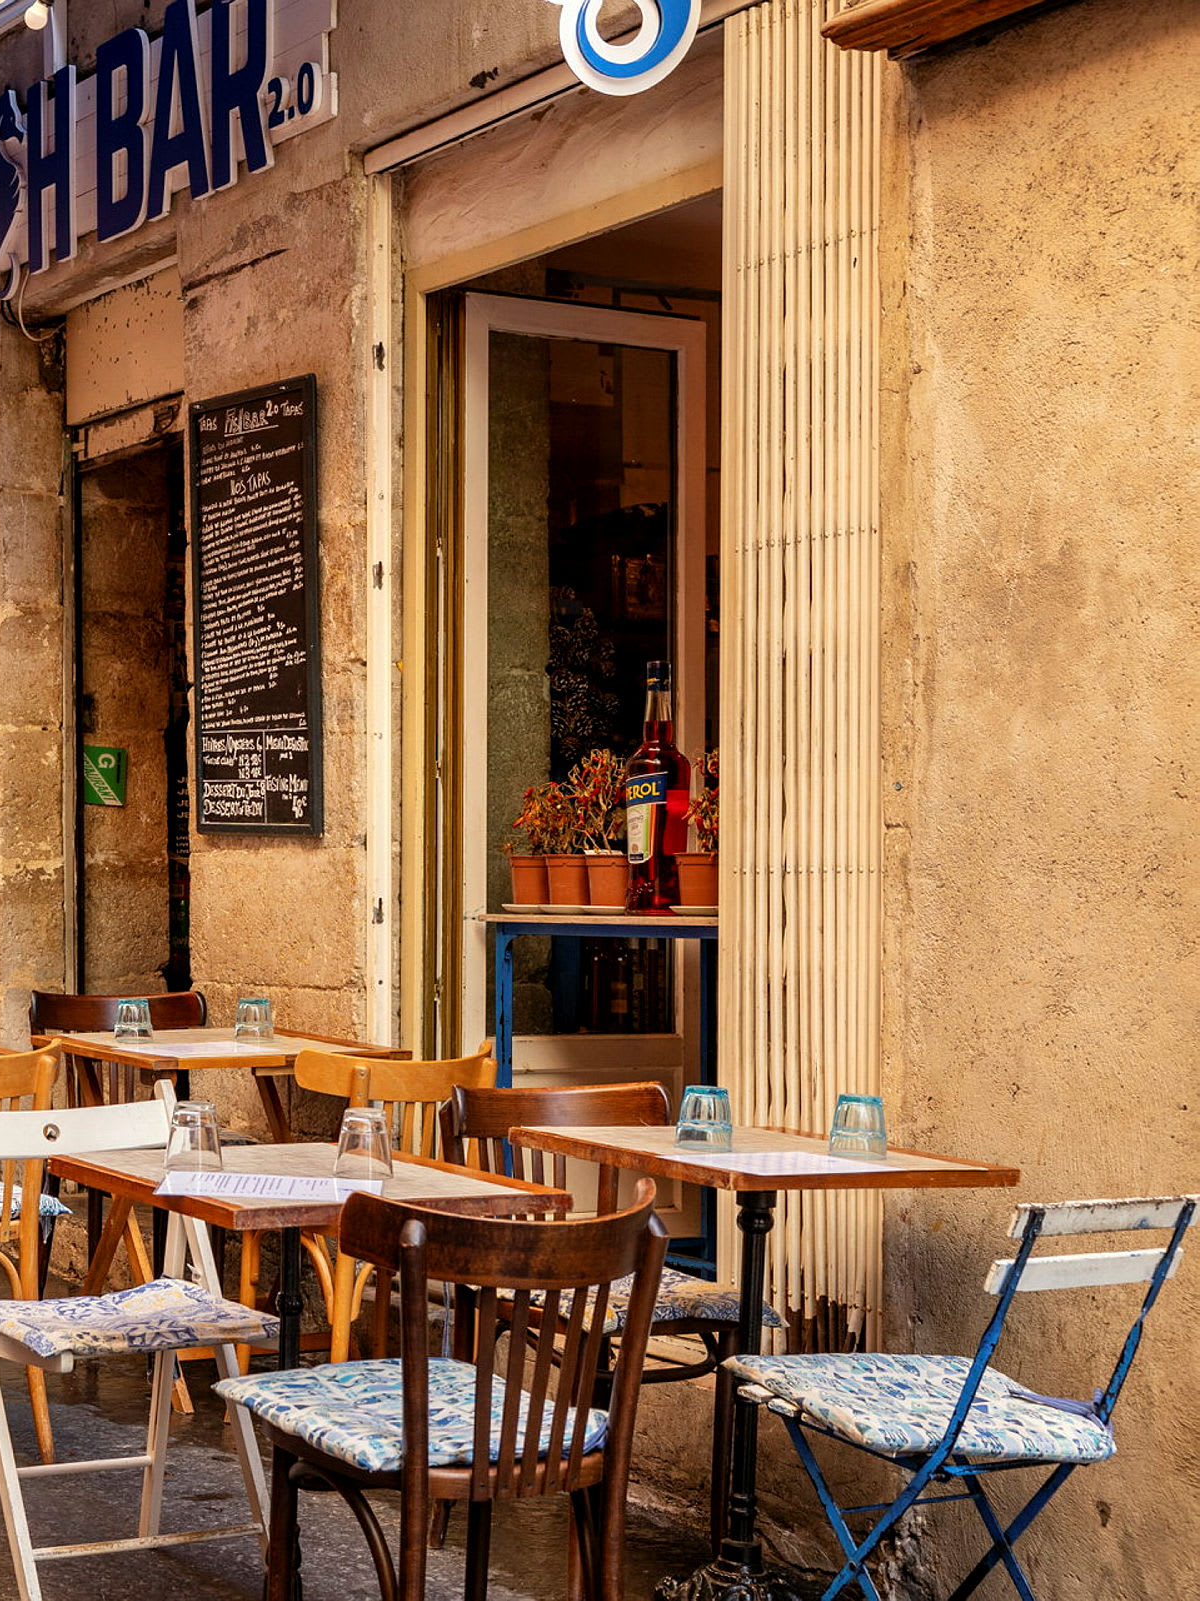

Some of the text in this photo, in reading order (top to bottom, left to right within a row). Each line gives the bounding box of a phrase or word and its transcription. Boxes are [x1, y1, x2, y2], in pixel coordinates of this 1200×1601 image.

[96, 0, 275, 243] BAR
[267, 61, 322, 131] 2.0
[247, 470, 271, 492] TAPAS
[626, 782, 660, 800] EROL
